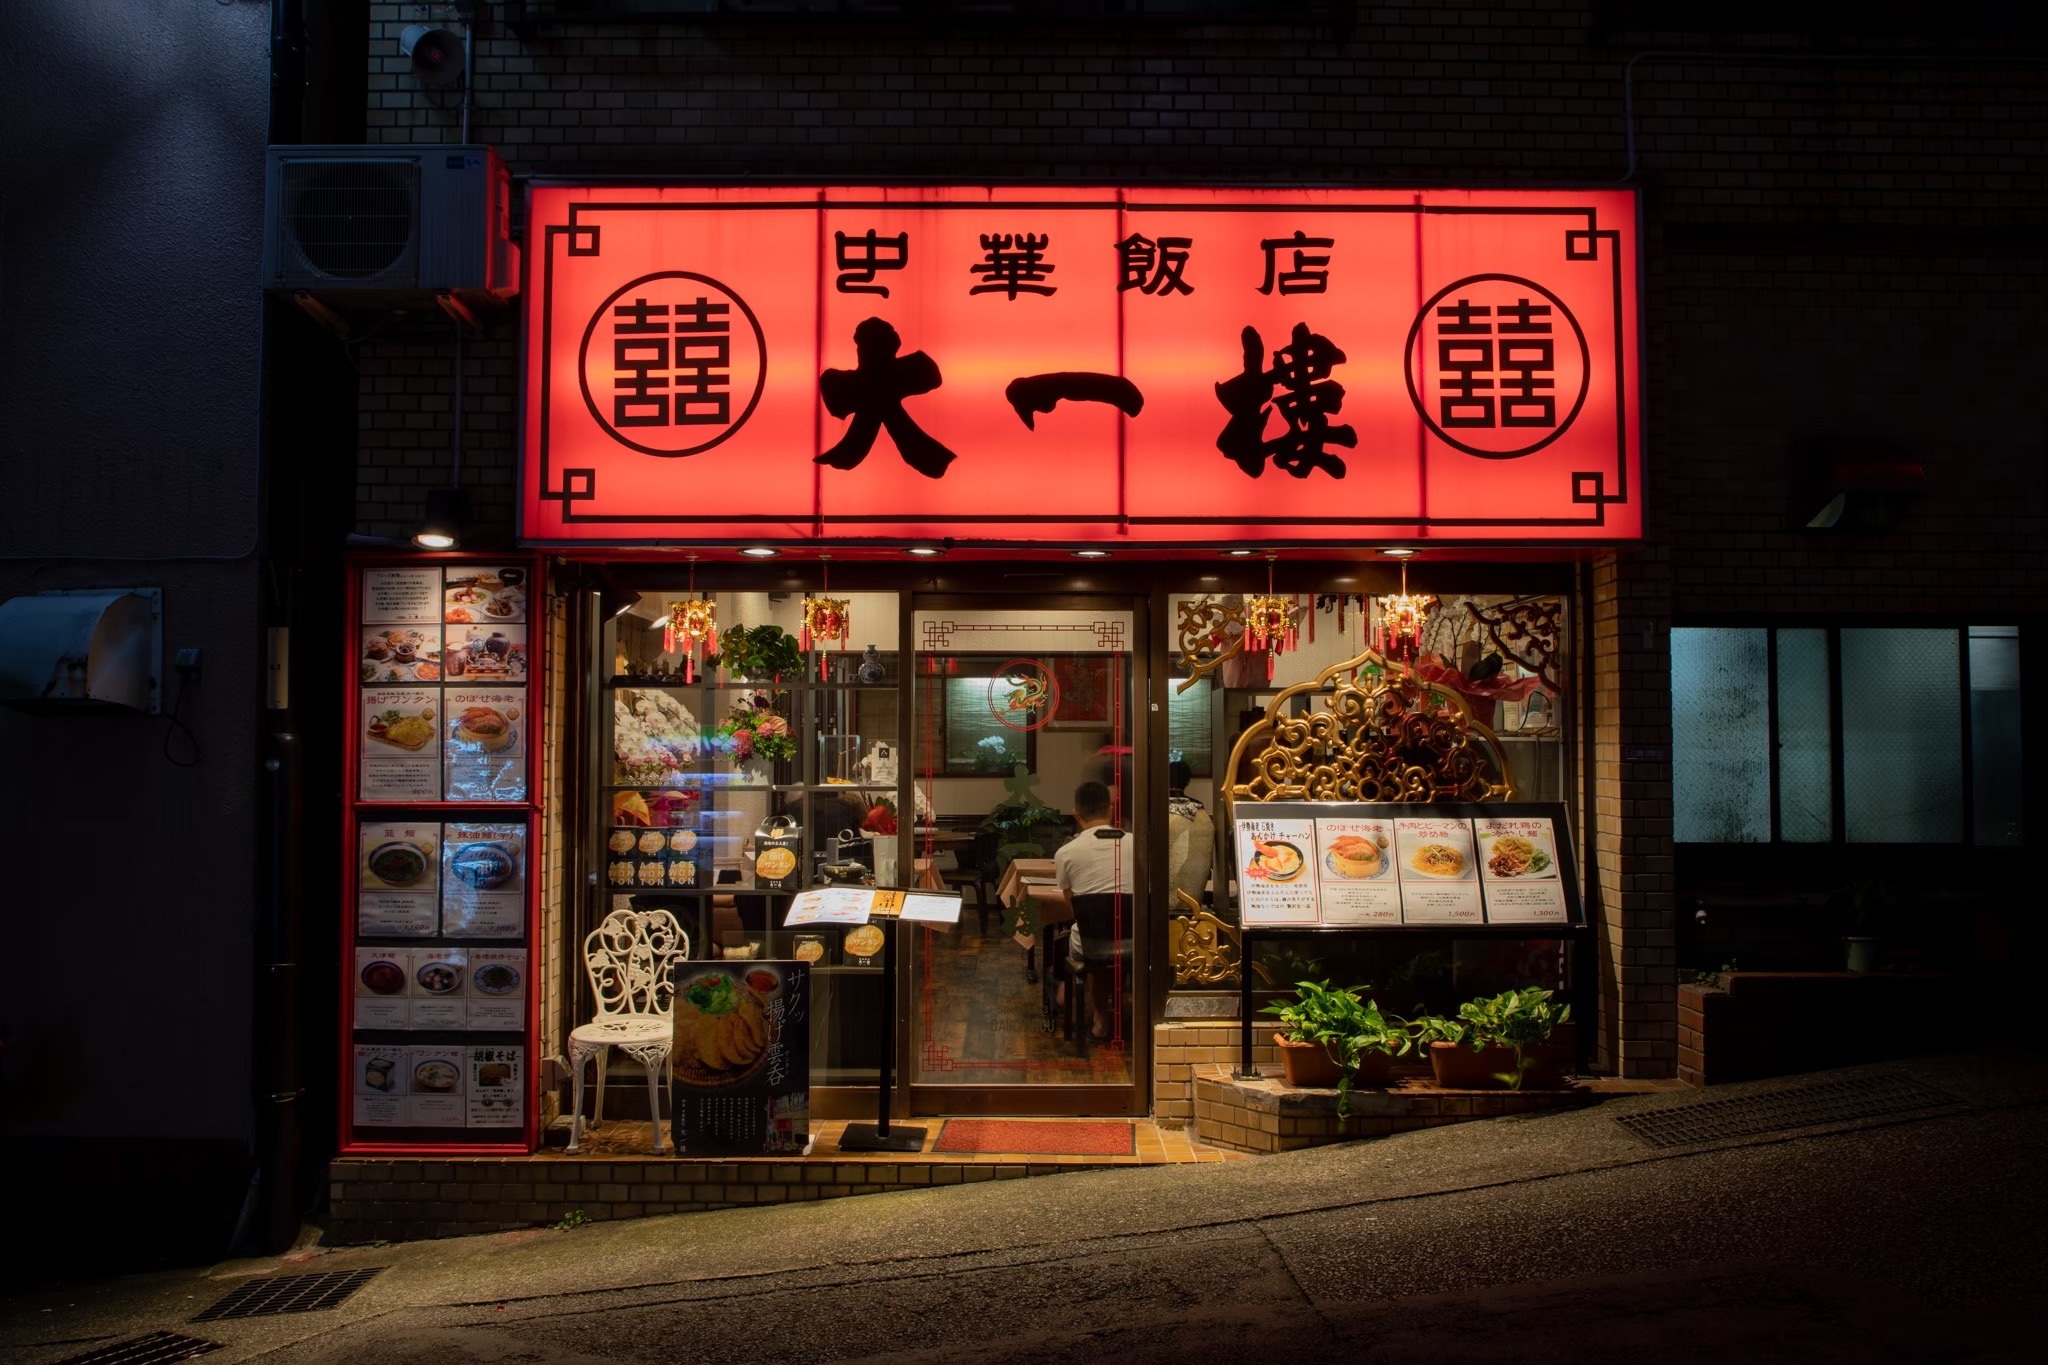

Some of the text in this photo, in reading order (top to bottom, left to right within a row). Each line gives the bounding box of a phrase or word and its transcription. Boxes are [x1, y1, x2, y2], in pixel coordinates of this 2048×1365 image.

[835, 229, 1335, 301] 中華飯店
[813, 316, 1359, 480] 大一樓
[366, 695, 435, 704] 揚げワンタン
[455, 694, 515, 703] のぼせ海老
[1326, 824, 1384, 833] のぼせ海老
[1486, 822, 1542, 830] よだれ鶏の
[1418, 830, 1449, 838] 炒め物
[670, 860, 694, 868] AGE
[610, 878, 634, 886] TON
[640, 878, 664, 886] TON
[788, 968, 806, 1024] サクッ
[766, 998, 786, 1086] 揚げ雲呑
[474, 1050, 516, 1062] 胡椒そば
